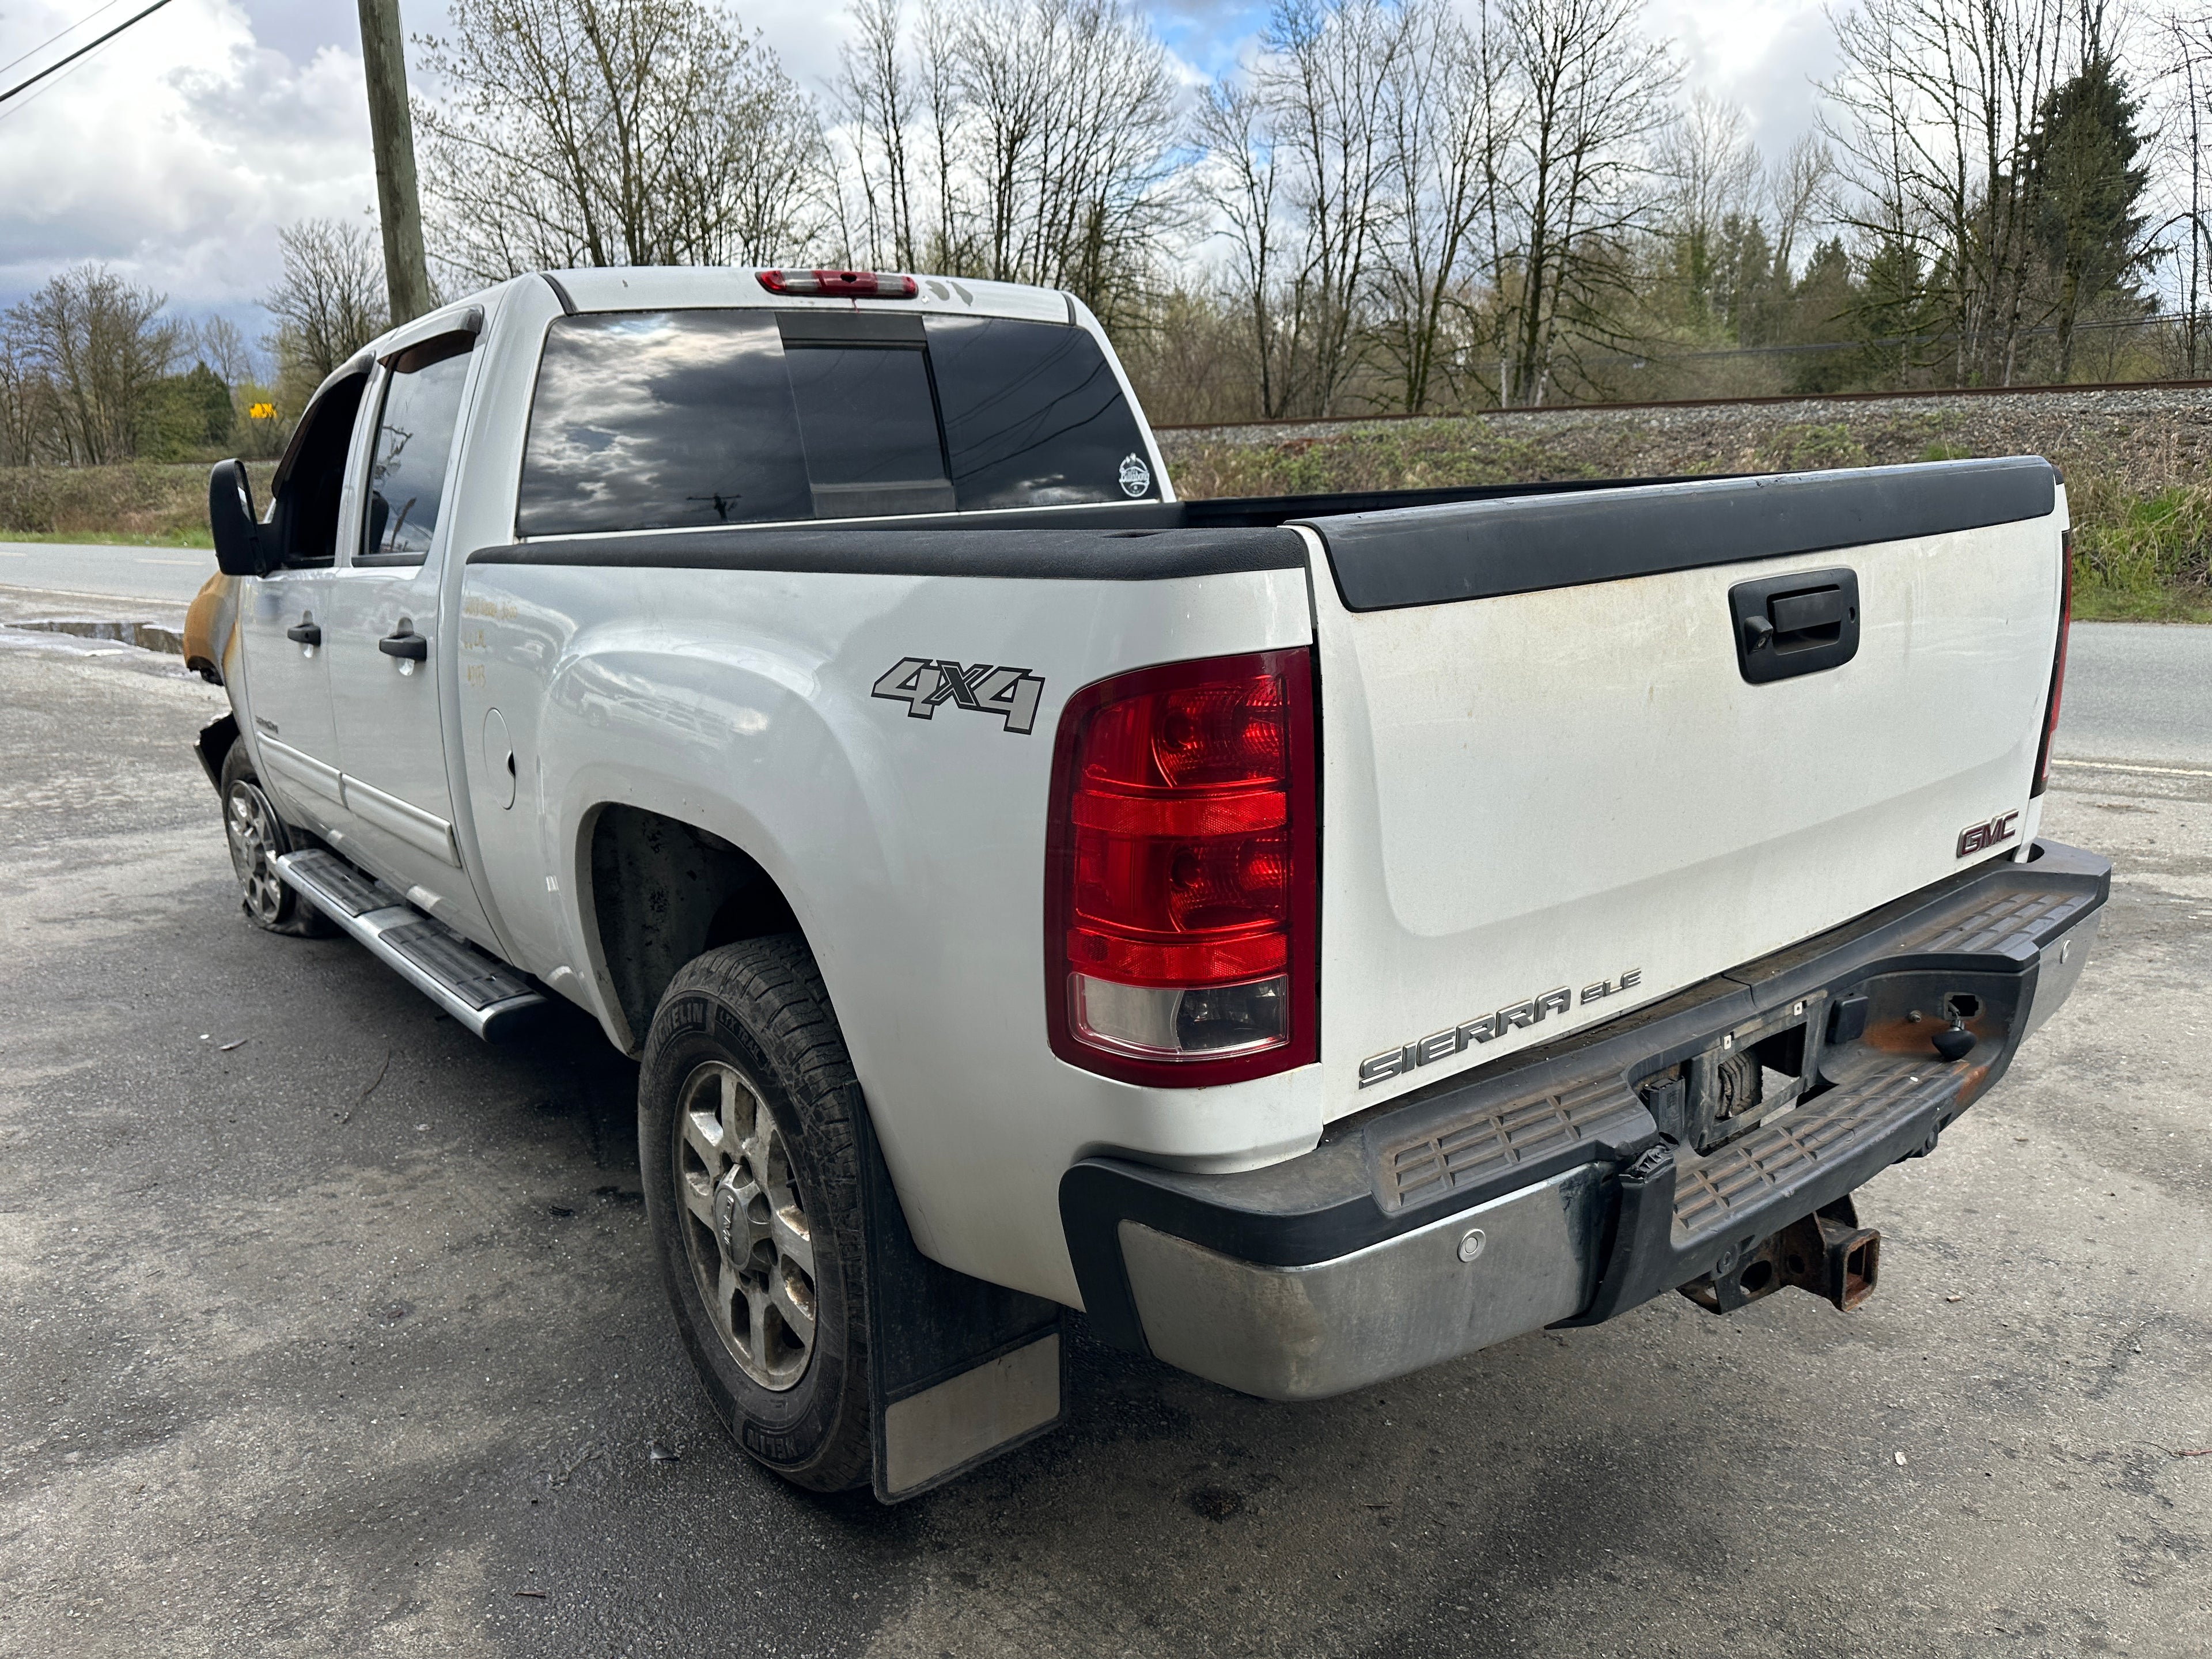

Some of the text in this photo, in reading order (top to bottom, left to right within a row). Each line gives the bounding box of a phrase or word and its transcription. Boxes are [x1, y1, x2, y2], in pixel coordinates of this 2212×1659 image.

[1957, 808, 2019, 858] GMC
[647, 1002, 704, 1070] MICHELIN
[1359, 968, 1642, 1090] SIERRA SLE
